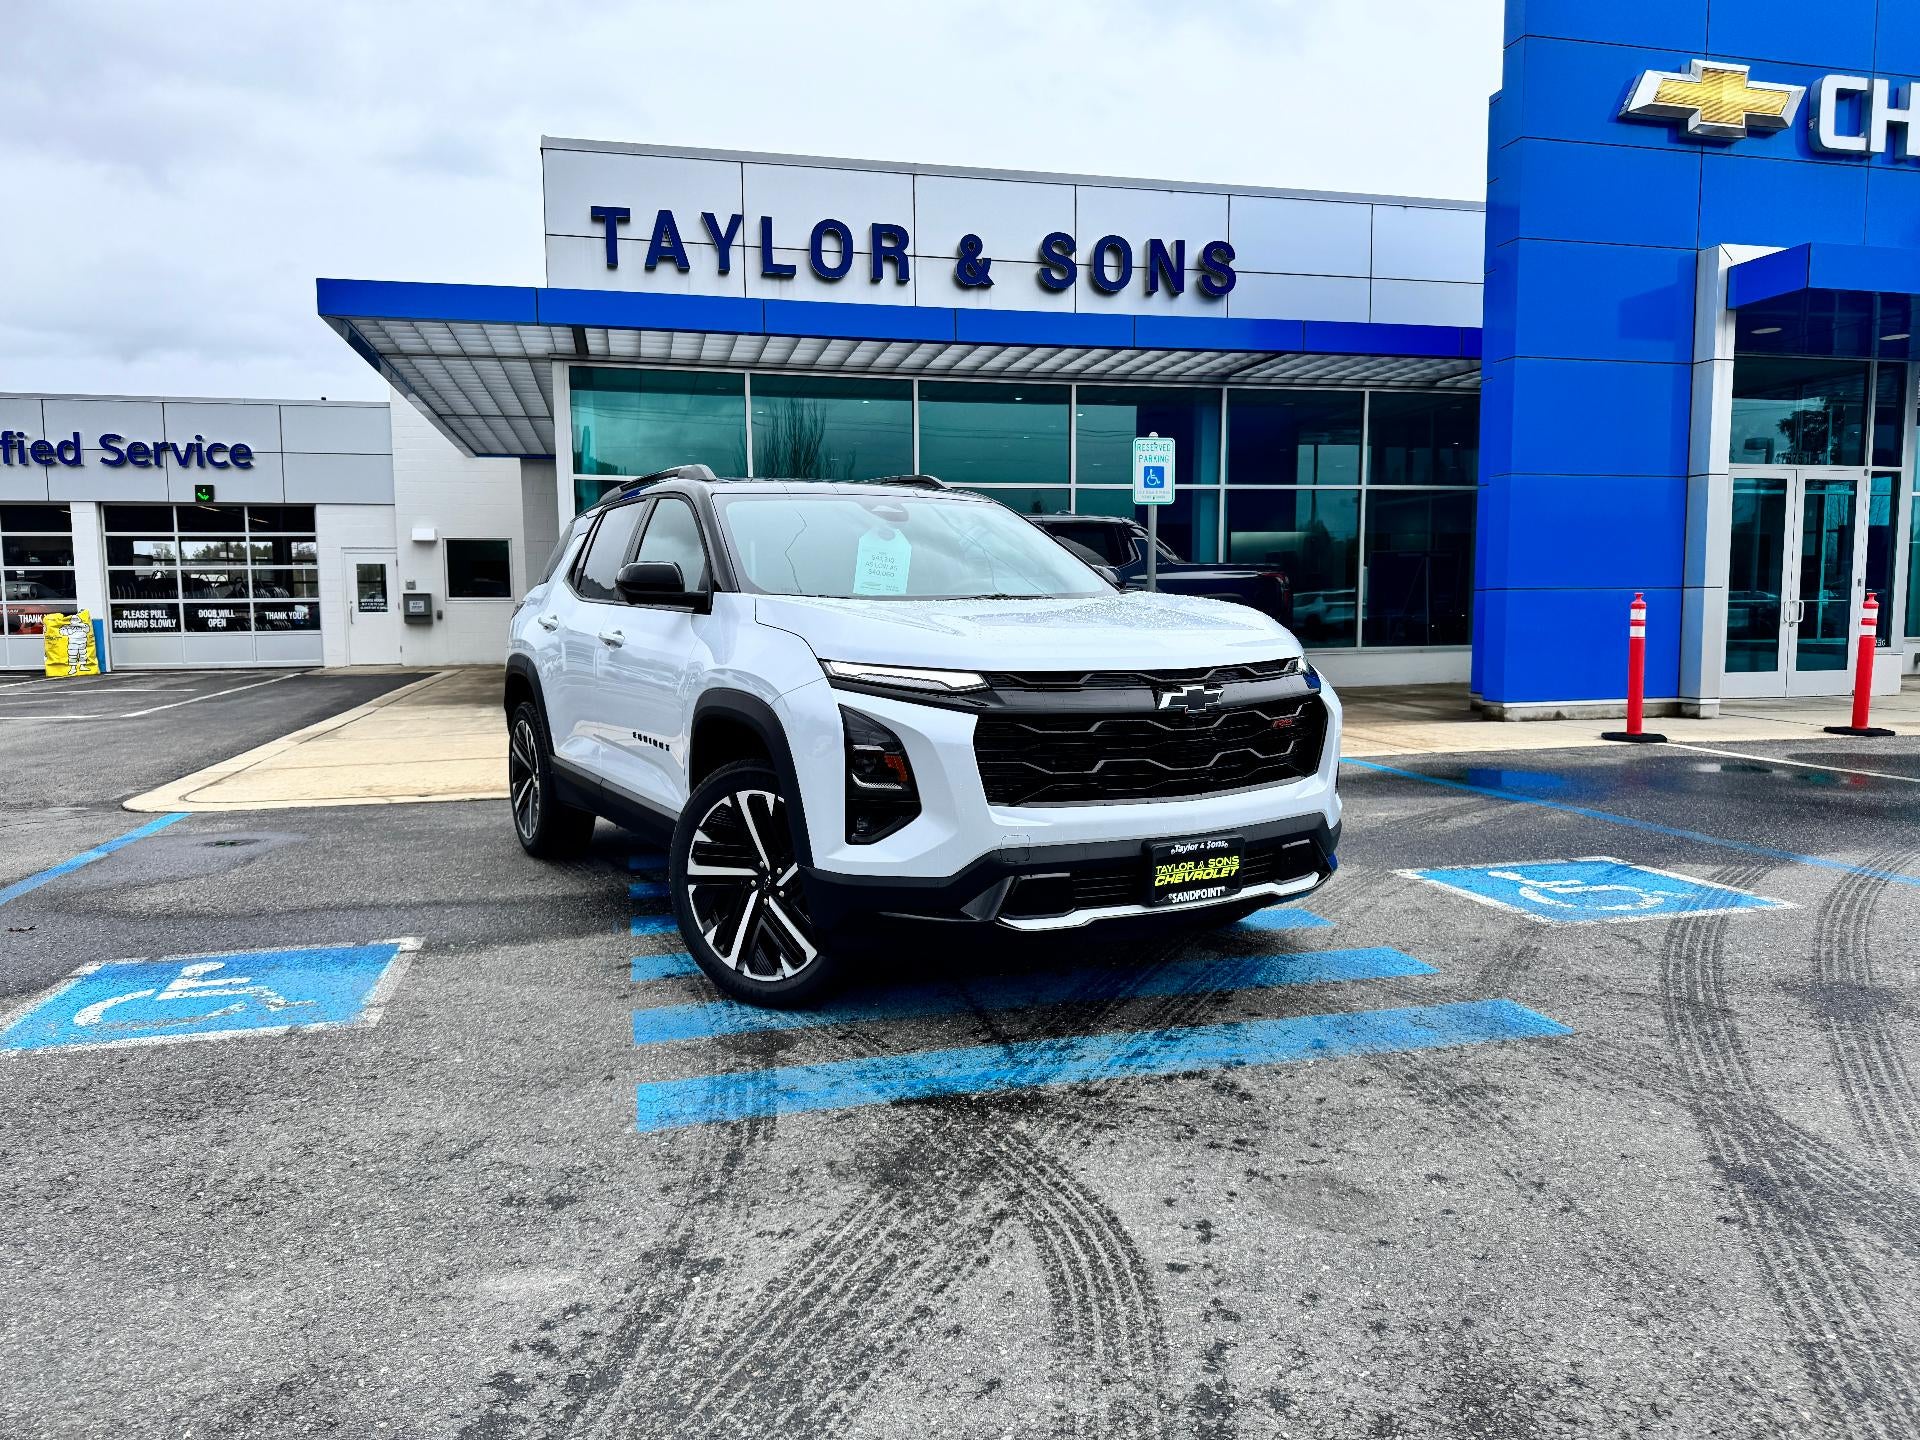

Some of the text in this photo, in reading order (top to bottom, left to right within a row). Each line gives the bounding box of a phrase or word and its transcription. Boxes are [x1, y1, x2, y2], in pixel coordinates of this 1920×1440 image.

[591, 205, 1238, 297] TAYLOR & SONS
[99, 434, 253, 469] Service
[1136, 443, 1171, 451] RESERVED
[1138, 454, 1170, 463] PARKING
[122, 609, 168, 619] PLEASE PULL
[217, 609, 236, 618] WILL
[264, 611, 288, 620] THANK
[18, 614, 43, 623] THANK
[208, 618, 227, 627] OPEN
[114, 619, 176, 628] FORWARD SLOWLY
[1174, 843, 1199, 854] Taylor
[1206, 840, 1226, 850] Sons
[1155, 855, 1240, 874] TAYLOR & SONS
[1154, 866, 1240, 887] CHEVROLET
